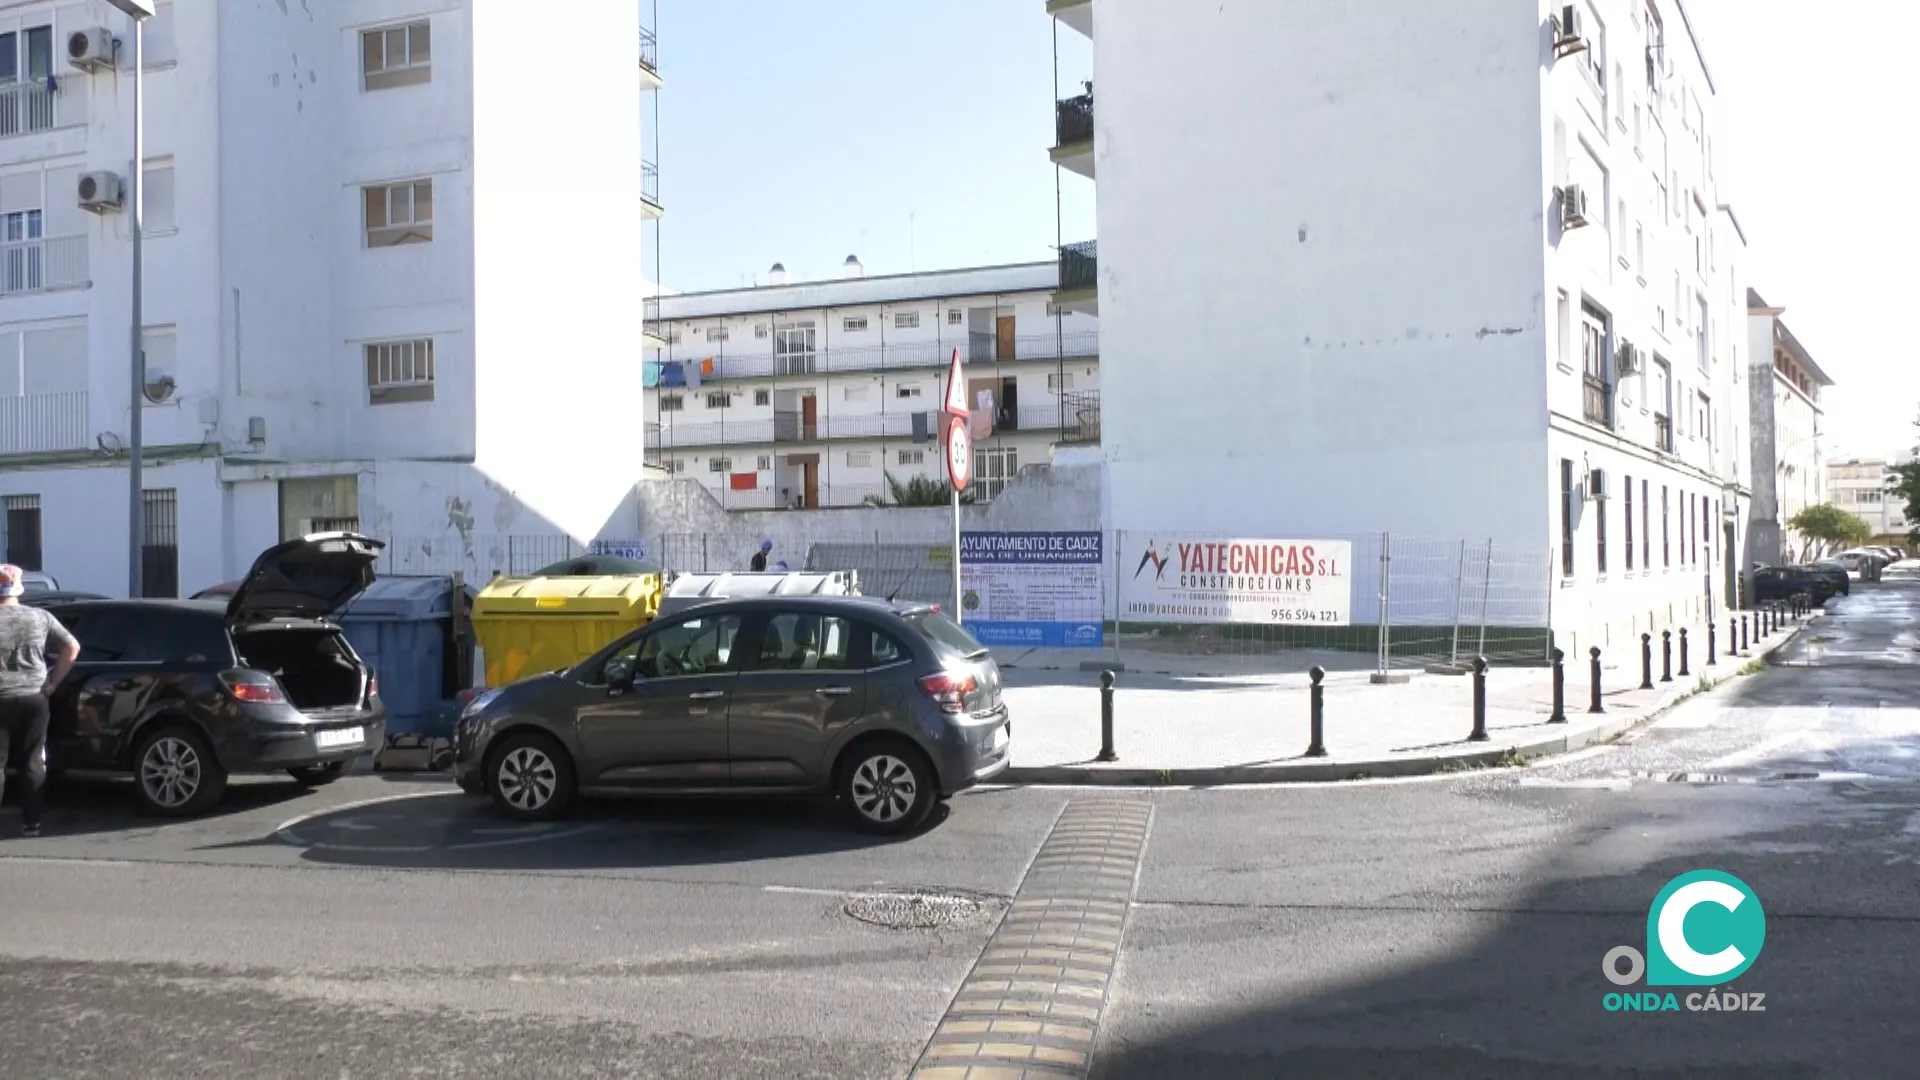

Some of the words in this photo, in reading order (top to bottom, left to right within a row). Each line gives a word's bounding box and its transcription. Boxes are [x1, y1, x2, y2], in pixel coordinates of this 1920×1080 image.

[954, 442, 965, 465] 30
[960, 536, 1046, 550] AYUNTAMIENTO
[1049, 536, 1064, 550] DE
[998, 551, 1015, 560] DE
[1018, 551, 1099, 560] URBANISMO
[1178, 542, 1315, 576] YATECNICAS
[1180, 575, 1312, 592] CONSTRUCCIONES
[1271, 609, 1292, 620] 956
[1295, 609, 1317, 621] 594
[1319, 610, 1338, 622] 121
